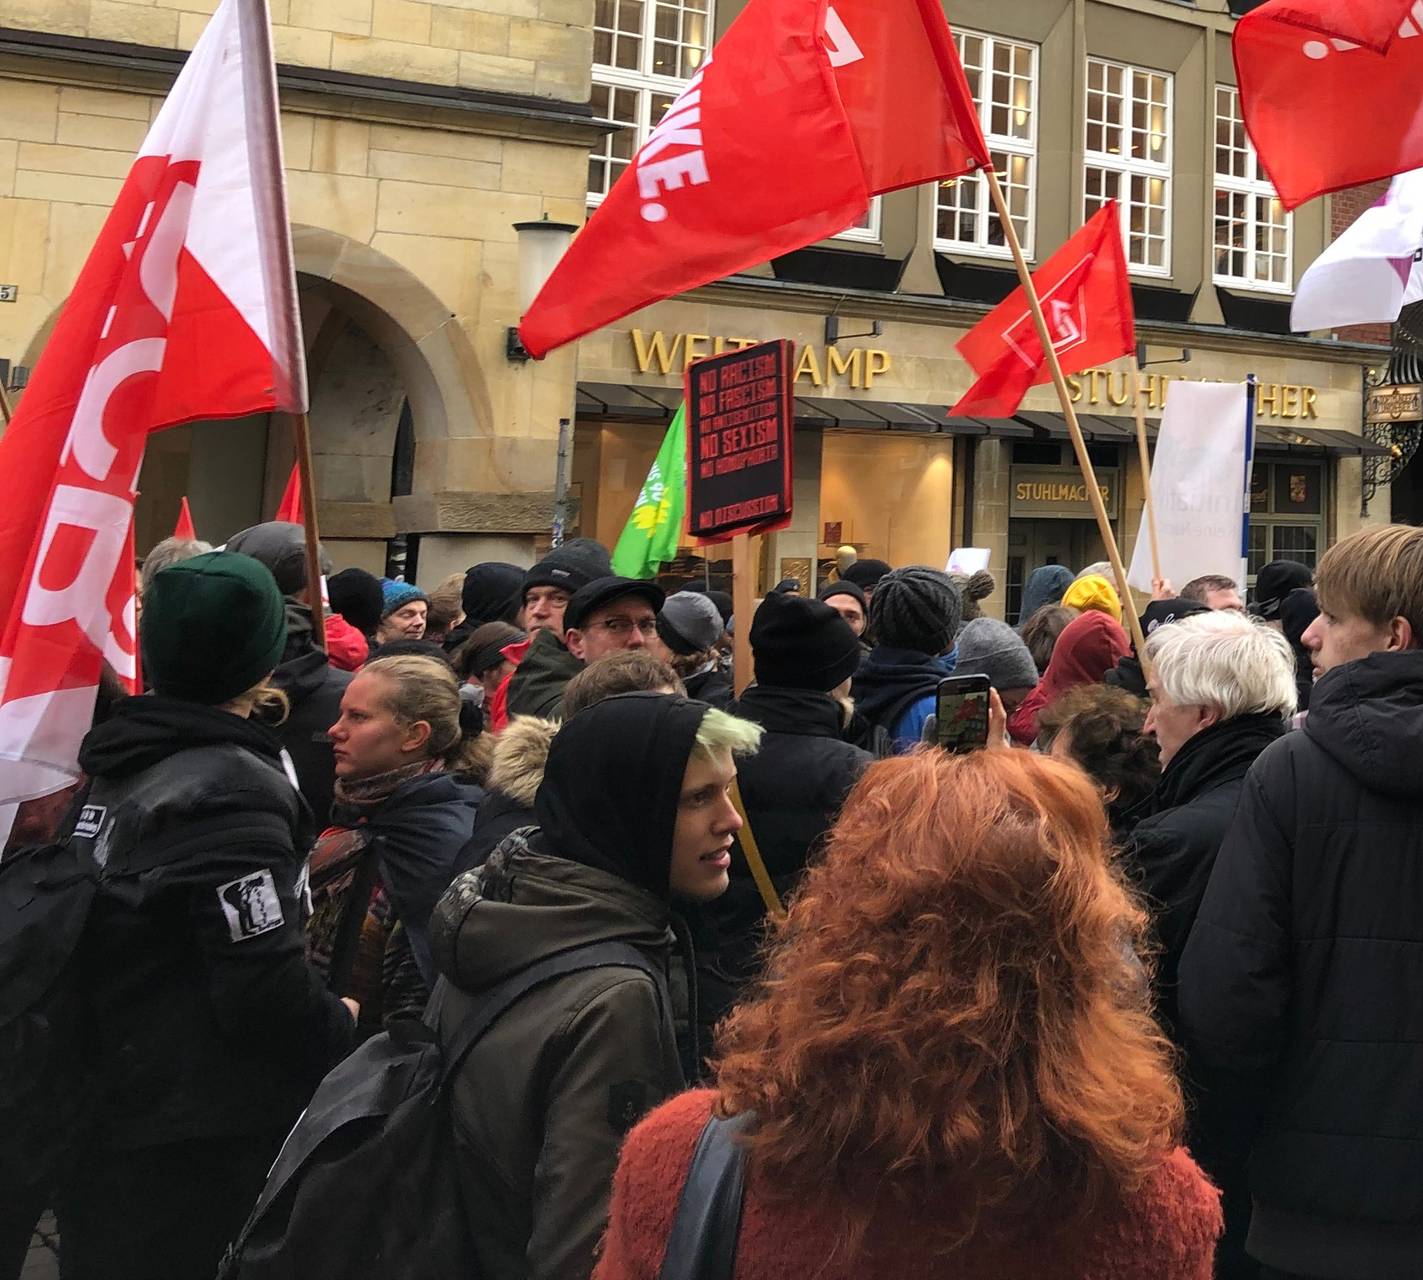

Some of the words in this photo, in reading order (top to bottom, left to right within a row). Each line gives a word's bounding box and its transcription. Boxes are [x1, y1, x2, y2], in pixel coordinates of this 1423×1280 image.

[699, 369, 717, 394] NO
[720, 353, 776, 389] RACISM
[699, 394, 716, 418] NO
[719, 378, 776, 411] FASCISM
[700, 433, 718, 459] NO
[723, 417, 777, 453] SEXISM
